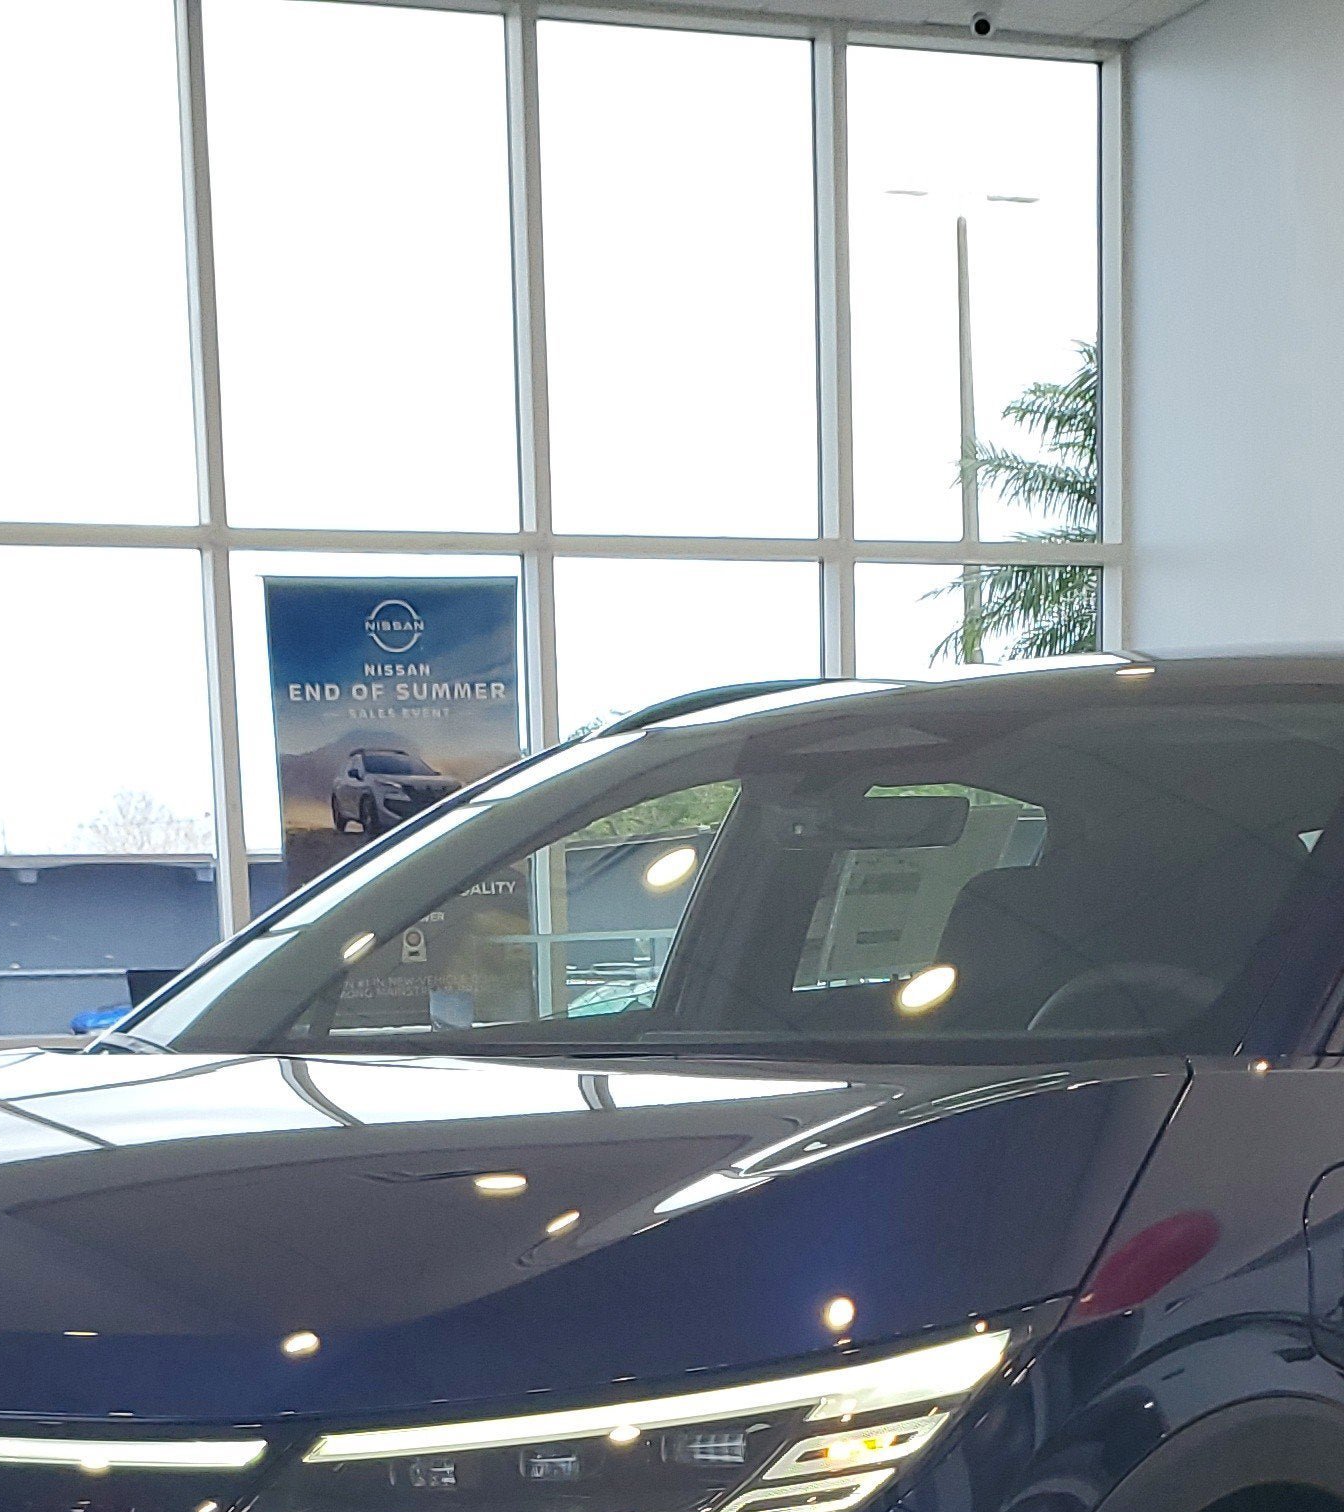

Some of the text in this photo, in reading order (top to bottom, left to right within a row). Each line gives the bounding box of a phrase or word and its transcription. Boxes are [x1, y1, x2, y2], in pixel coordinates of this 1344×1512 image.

[365, 621, 425, 632] NISSAN
[364, 663, 431, 677] NISSAN
[288, 682, 506, 701] END OF SUMMER
[348, 707, 450, 719] SALES EVENT
